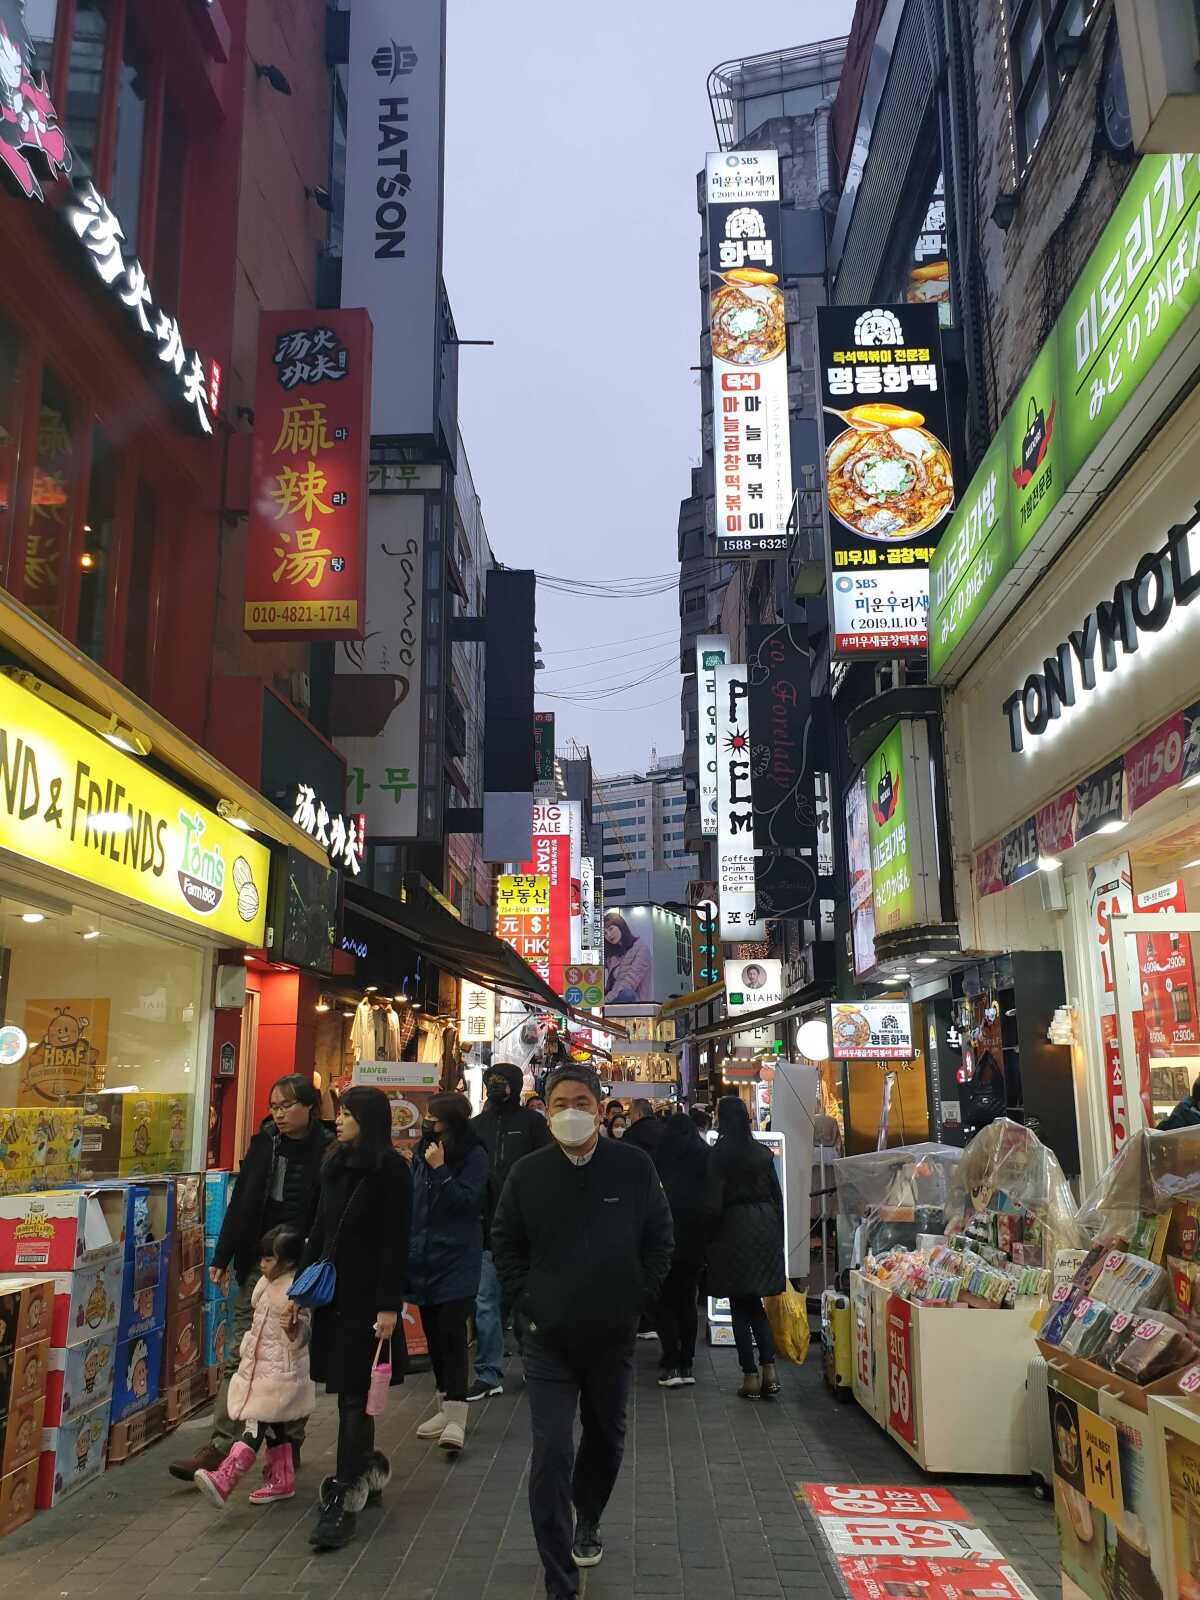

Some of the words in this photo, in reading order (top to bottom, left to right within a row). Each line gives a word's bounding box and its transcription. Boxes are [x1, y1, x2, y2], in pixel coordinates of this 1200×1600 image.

[741, 157, 759, 165] SBS
[374, 98, 409, 260] HATSON
[712, 175, 775, 187] 미운우리새끼
[719, 240, 773, 267] 화떡
[1076, 153, 1200, 373] 미도리가
[833, 350, 892, 364] 즉석떡볶이
[895, 348, 930, 362] 전문점
[827, 364, 938, 395] 명동화떡
[744, 395, 764, 530] 마늘떡볶이
[271, 398, 336, 588] 麻辣湯
[1020, 464, 1054, 528] 가방전문점
[936, 471, 998, 608] 미도리가방
[886, 547, 935, 565] 곱창떡
[855, 579, 878, 589] SBS
[941, 549, 994, 645] みどりかばん
[252, 605, 351, 624] 010-4821-1714
[44, 777, 63, 829] &
[70, 760, 168, 878] FRIENDS
[532, 806, 561, 821] BIG
[532, 822, 561, 833] SALE
[180, 812, 224, 888] Tom's
[873, 821, 907, 871] 미도리가방
[536, 839, 551, 873] STAR
[721, 855, 754, 863] Coffee
[721, 864, 746, 872] Drink
[500, 889, 547, 905] 부동산
[722, 884, 744, 892] Beer
[501, 916, 519, 933] 元
[727, 911, 757, 926] 포엠
[524, 938, 547, 954] HK
[746, 993, 782, 1002] RIAHN
[871, 1034, 910, 1045] 명동화떡
[44, 1048, 88, 1067] HBAF
[360, 1066, 388, 1074] NAVER
[1182, 1229, 1197, 1242] GIFT
[1055, 1286, 1069, 1299] 50
[890, 1329, 905, 1368] 최대
[890, 1362, 910, 1424] 50
[1086, 1446, 1115, 1500] 1+1
[823, 1486, 888, 1514] 50
[882, 1490, 927, 1513] 최대
[845, 1523, 900, 1547] LE
[896, 1522, 952, 1549] SA
